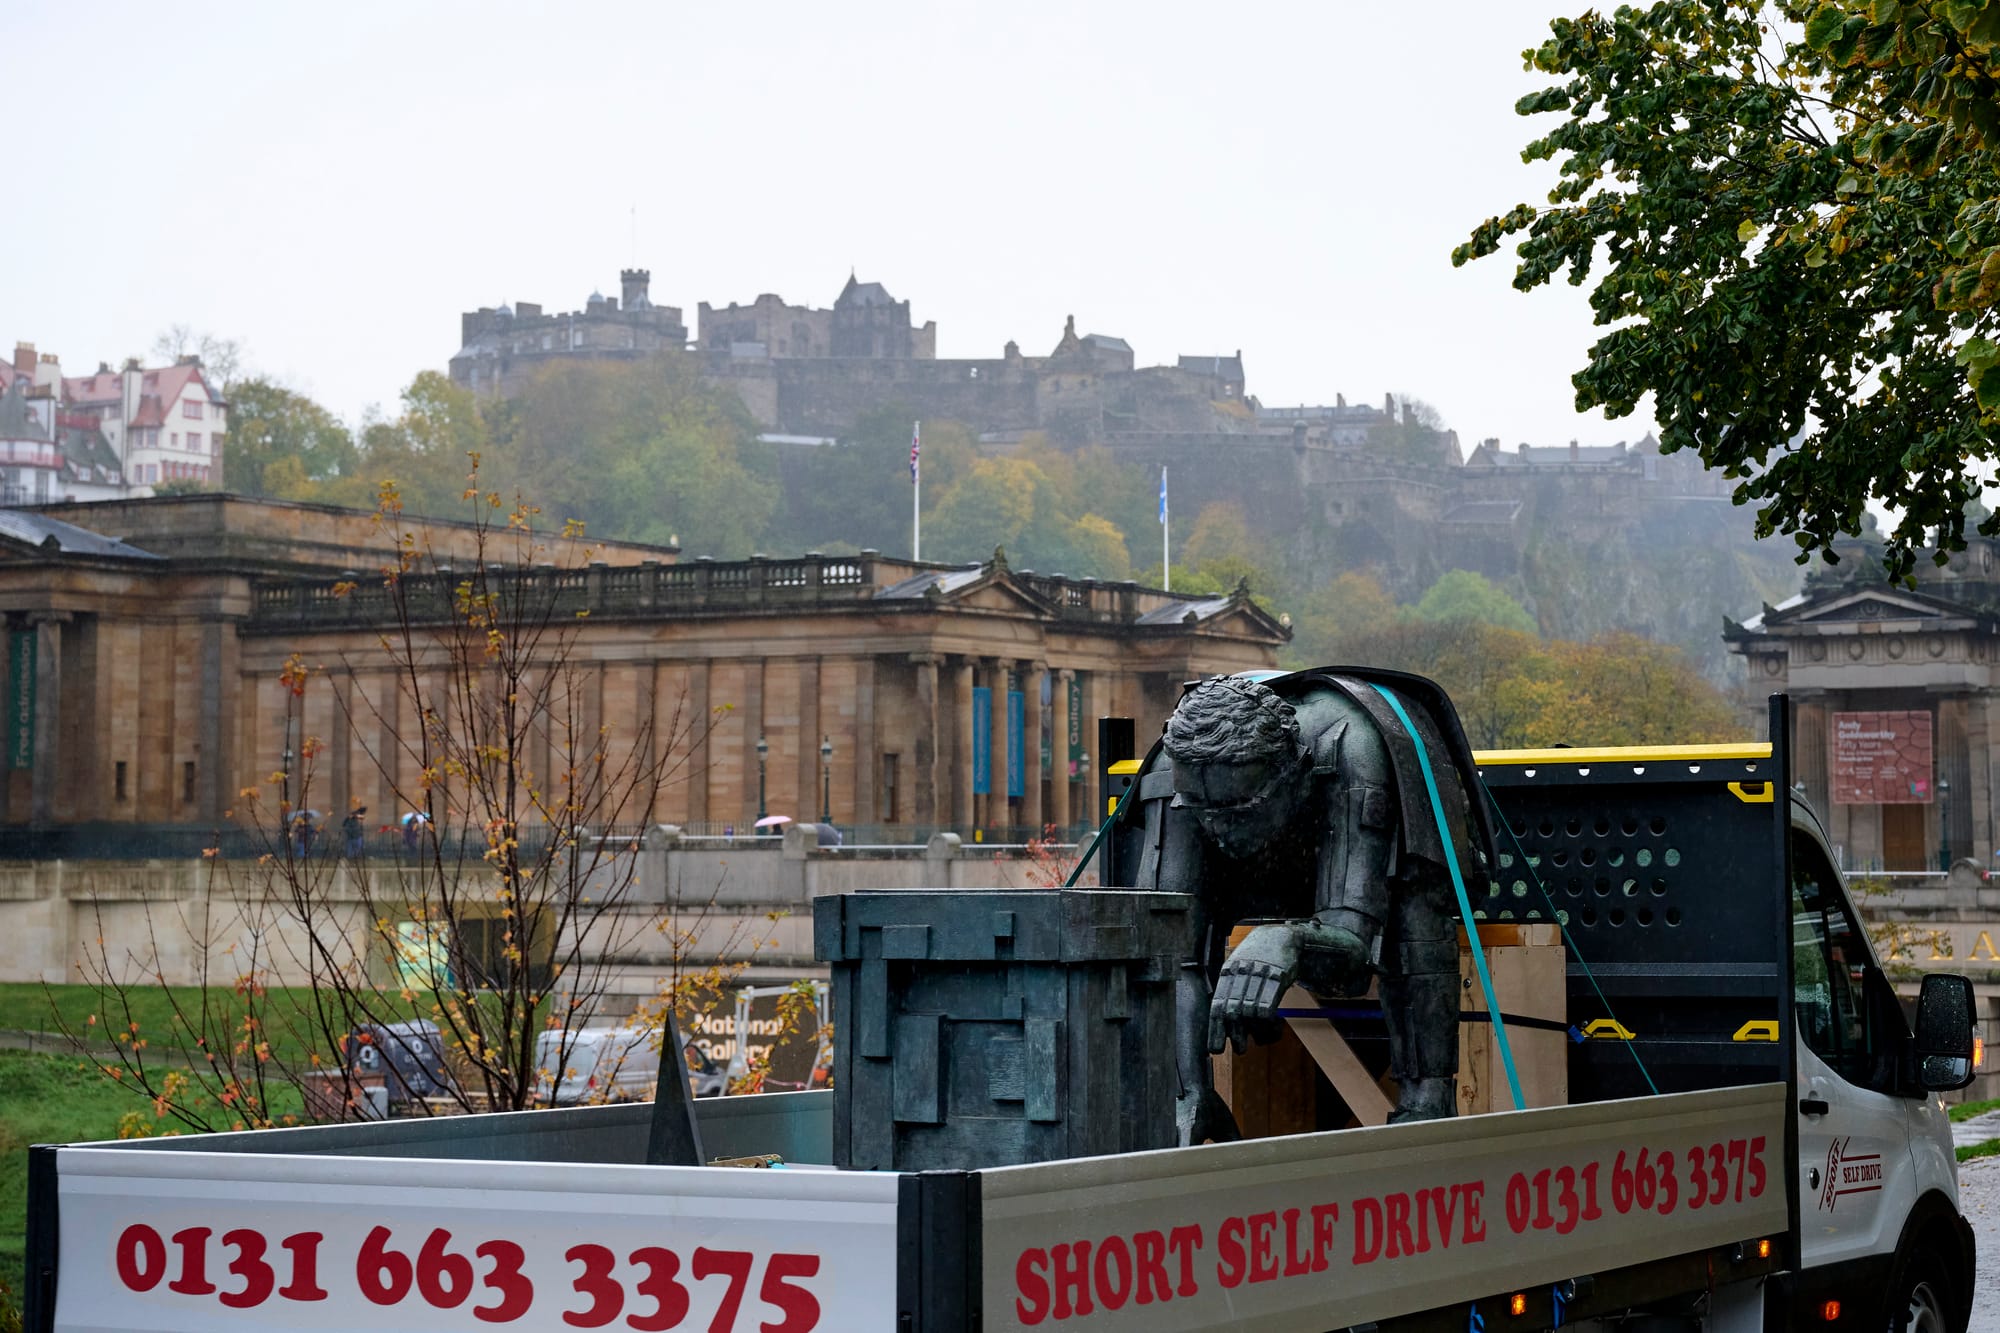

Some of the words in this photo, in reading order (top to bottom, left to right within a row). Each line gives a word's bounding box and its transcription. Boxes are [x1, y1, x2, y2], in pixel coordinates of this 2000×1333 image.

[15, 727, 30, 768] Free
[1070, 685, 1081, 746] Gallery
[1826, 1140, 1840, 1208] SHORT
[1843, 1166, 1860, 1184] SELF
[1861, 1163, 1882, 1182] DRIVE
[1015, 1223, 1204, 1326] SHORT
[1216, 1202, 1340, 1289] SELF
[1351, 1180, 1487, 1265] DRIVE
[1505, 1161, 1603, 1235] 0131
[1611, 1147, 1679, 1215] 663
[1687, 1136, 1767, 1209] 3375
[116, 1224, 328, 1308] 0131
[356, 1225, 534, 1323] 663
[562, 1243, 821, 1333] 3375
